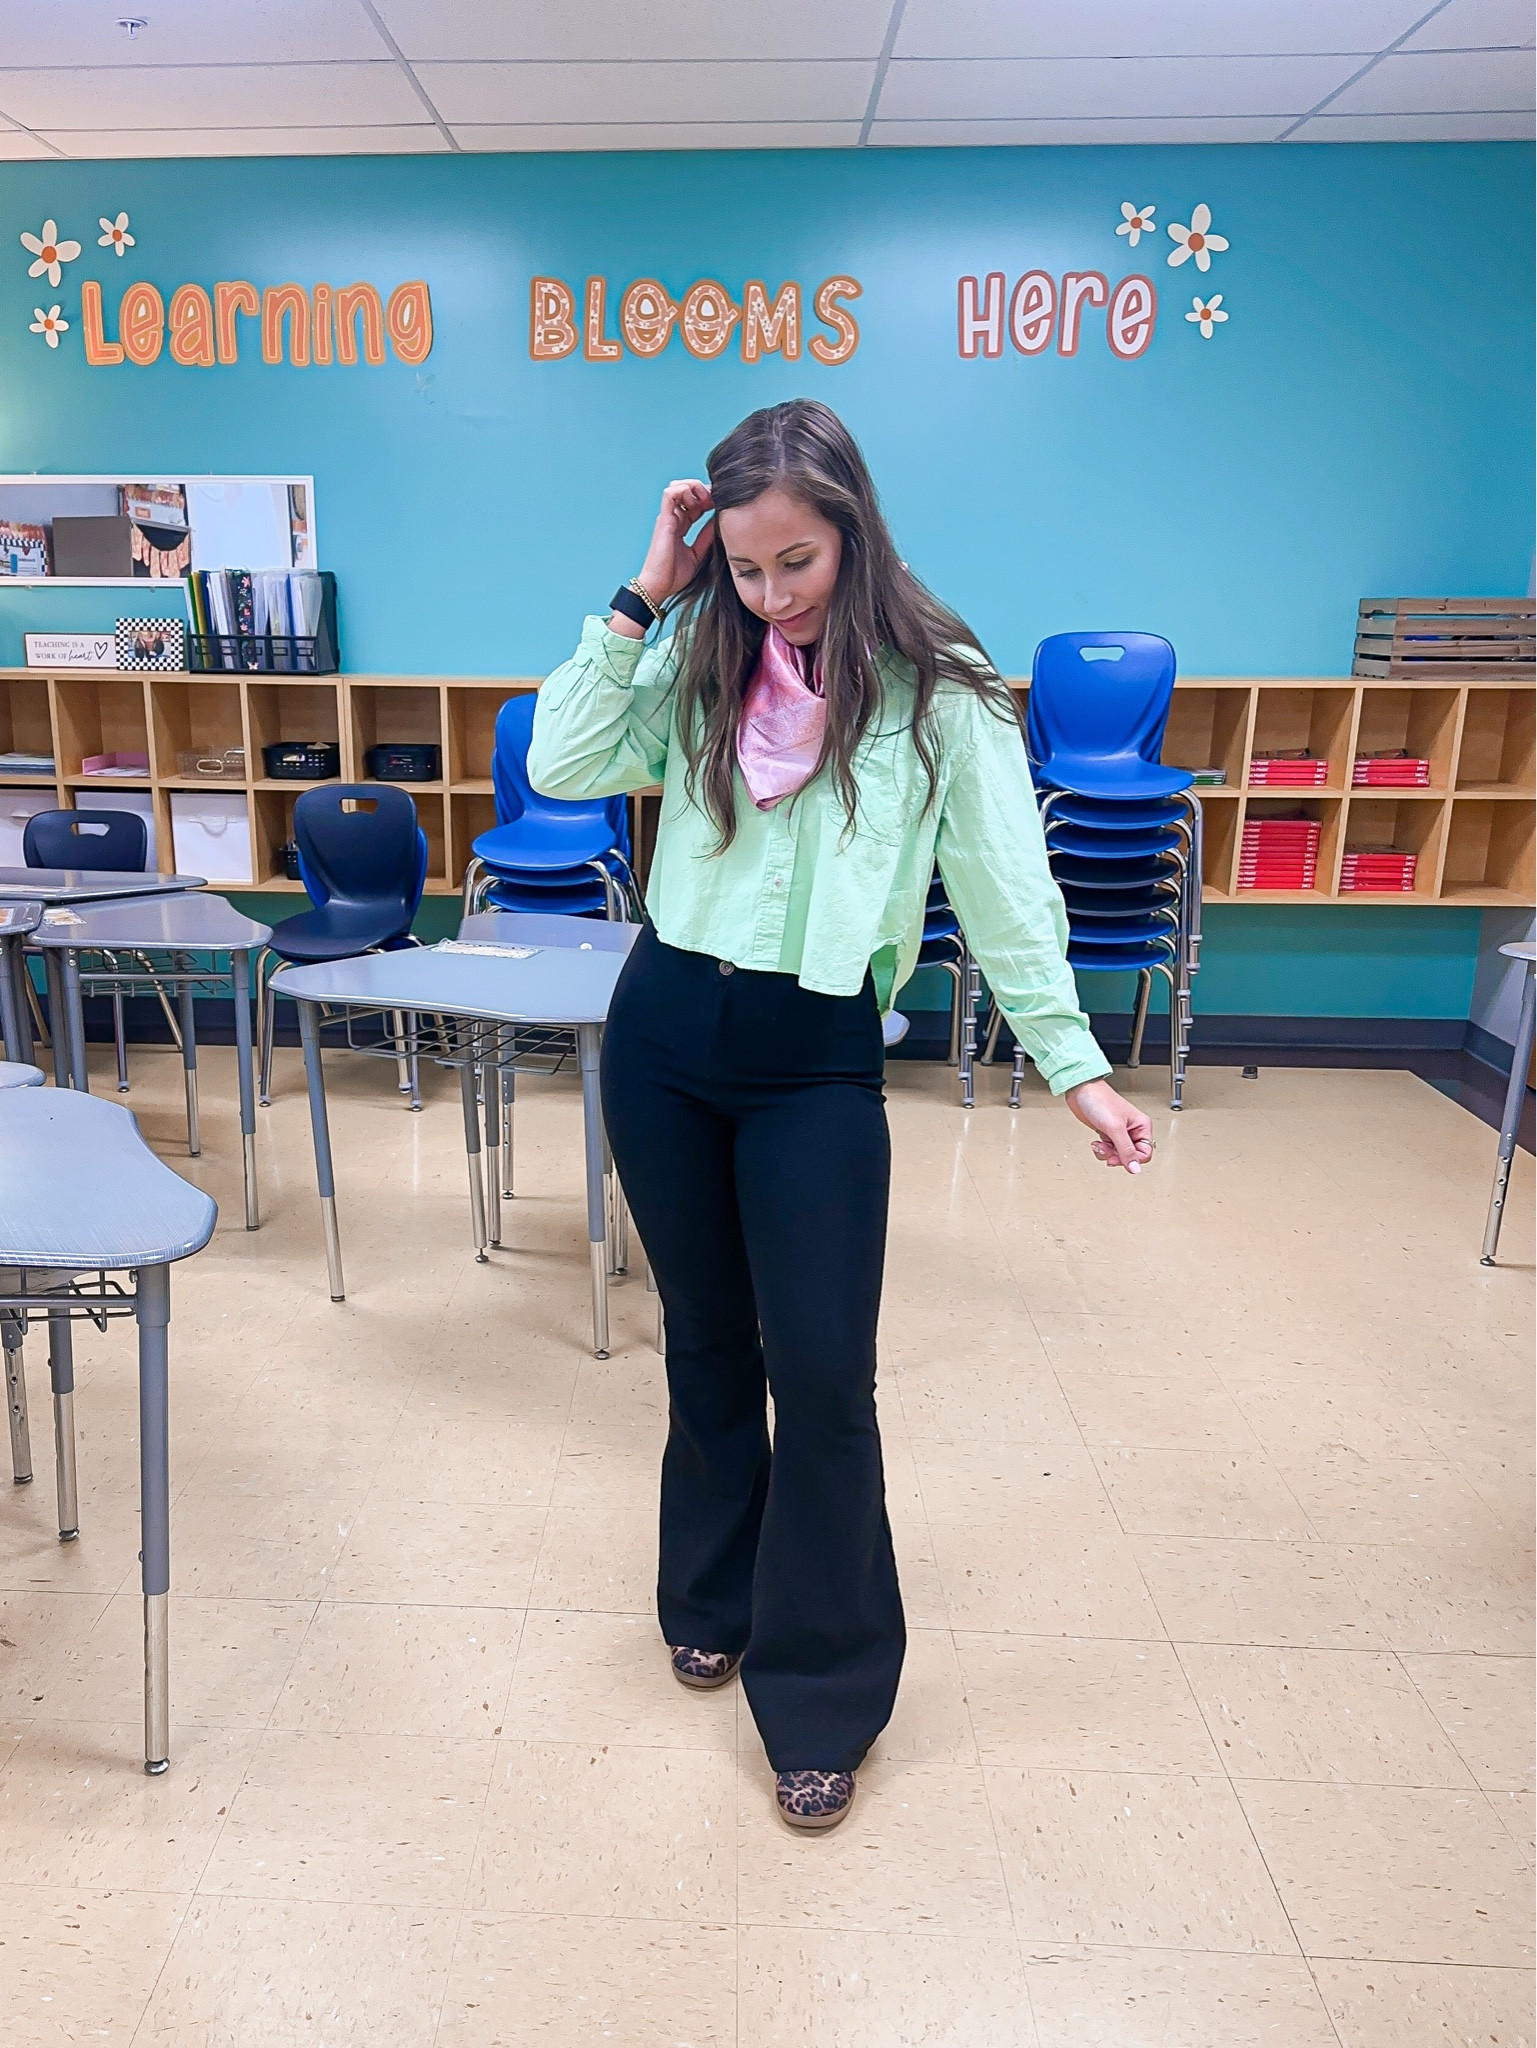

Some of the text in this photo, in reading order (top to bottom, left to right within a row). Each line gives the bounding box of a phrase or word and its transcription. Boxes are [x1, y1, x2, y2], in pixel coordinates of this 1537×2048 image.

[82, 269, 1157, 367] Learning BLOOMS Here
[68, 649, 94, 662] heart
